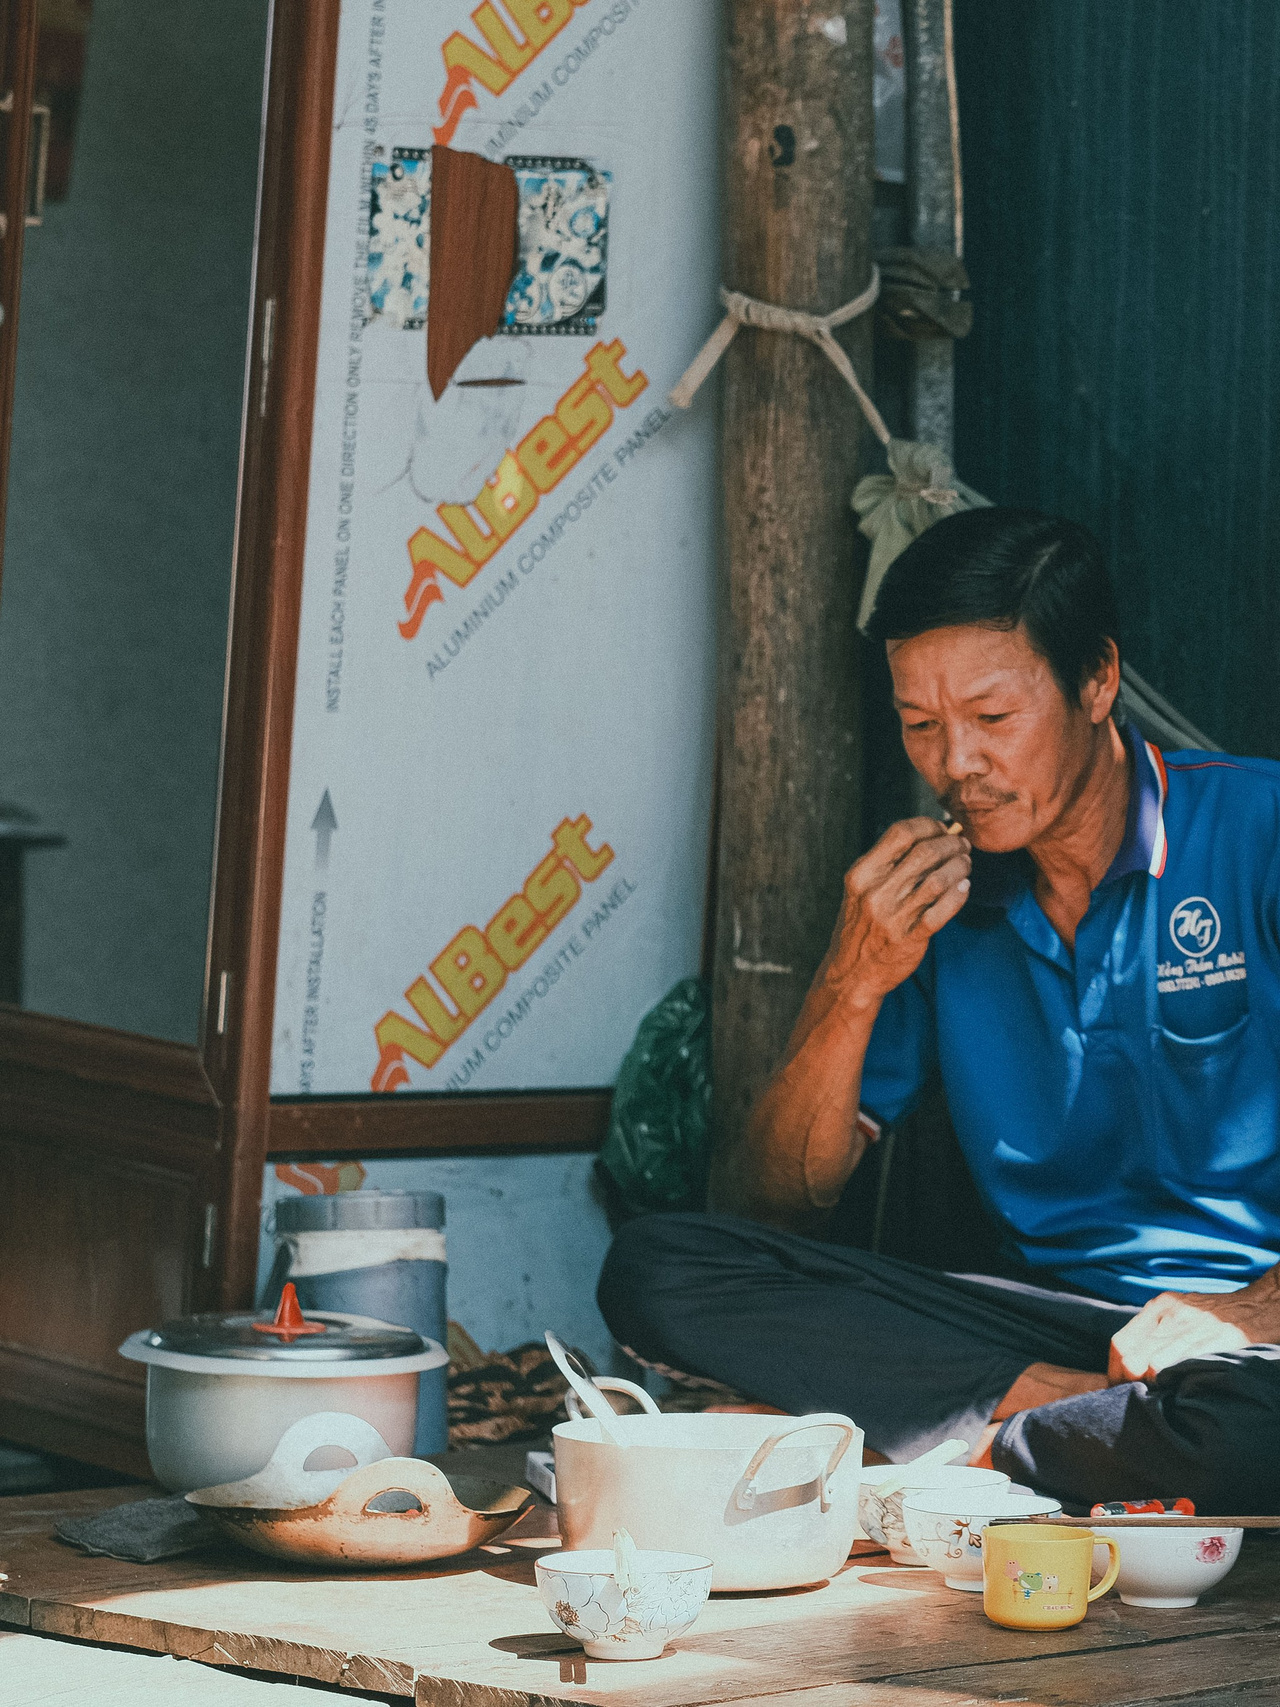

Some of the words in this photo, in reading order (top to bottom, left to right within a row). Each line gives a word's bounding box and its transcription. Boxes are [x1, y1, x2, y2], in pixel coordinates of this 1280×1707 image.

[368, 16, 385, 68] AFTER
[552, 0, 640, 86] COMPOS
[346, 344, 362, 388] ONLY
[341, 391, 359, 477] DIRECTION
[339, 481, 355, 515] ONE
[337, 518, 351, 543] ON
[424, 569, 520, 681] ALUMINIUM
[517, 461, 618, 576] COMPOSITE
[613, 405, 673, 469] PANEL
[332, 546, 350, 597] PANEL
[329, 600, 346, 645] EACH
[326, 648, 343, 713] INSTALL
[306, 889, 327, 1001] INSTALLATION
[482, 933, 586, 1053] COMPOSITE
[583, 876, 640, 940] PANEL
[302, 1005, 320, 1055] AFTER
[299, 1059, 316, 1093] AYS
